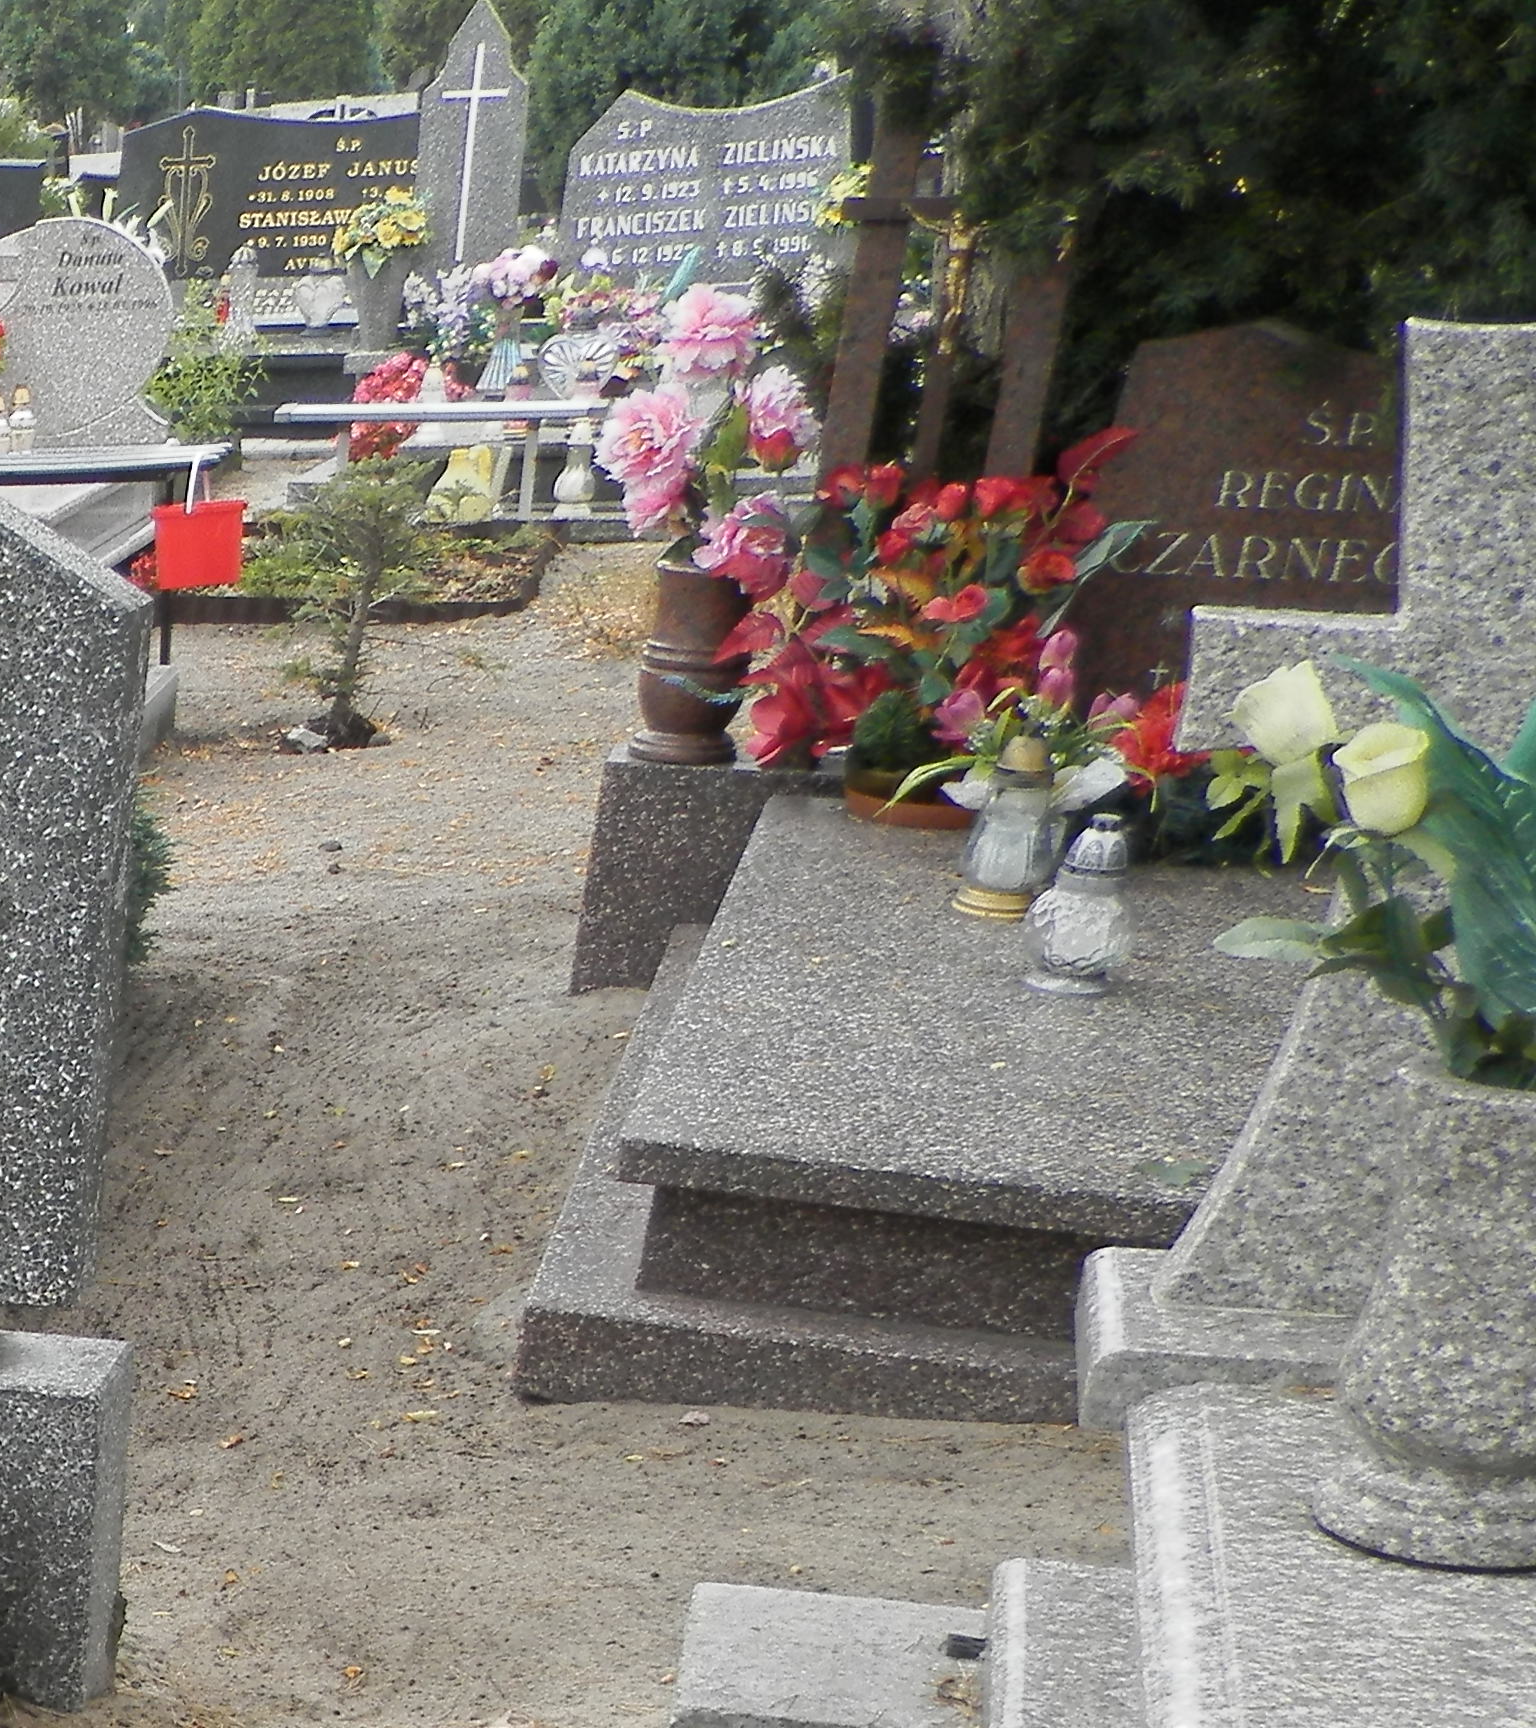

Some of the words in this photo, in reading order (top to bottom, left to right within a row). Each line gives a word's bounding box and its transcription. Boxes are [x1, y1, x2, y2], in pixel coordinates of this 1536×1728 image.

[259, 161, 331, 182] JÓZEF
[579, 147, 698, 176] KATARZYNA
[723, 136, 837, 165] ZIELIŃSKA
[576, 208, 706, 240] FRANCISZEK
[724, 199, 818, 230] ZIELIŃS
[58, 250, 123, 268] Danuta
[51, 272, 123, 297] Kowal
[1302, 400, 1375, 446] Ś.P.
[1214, 470, 1400, 515] REGIN
